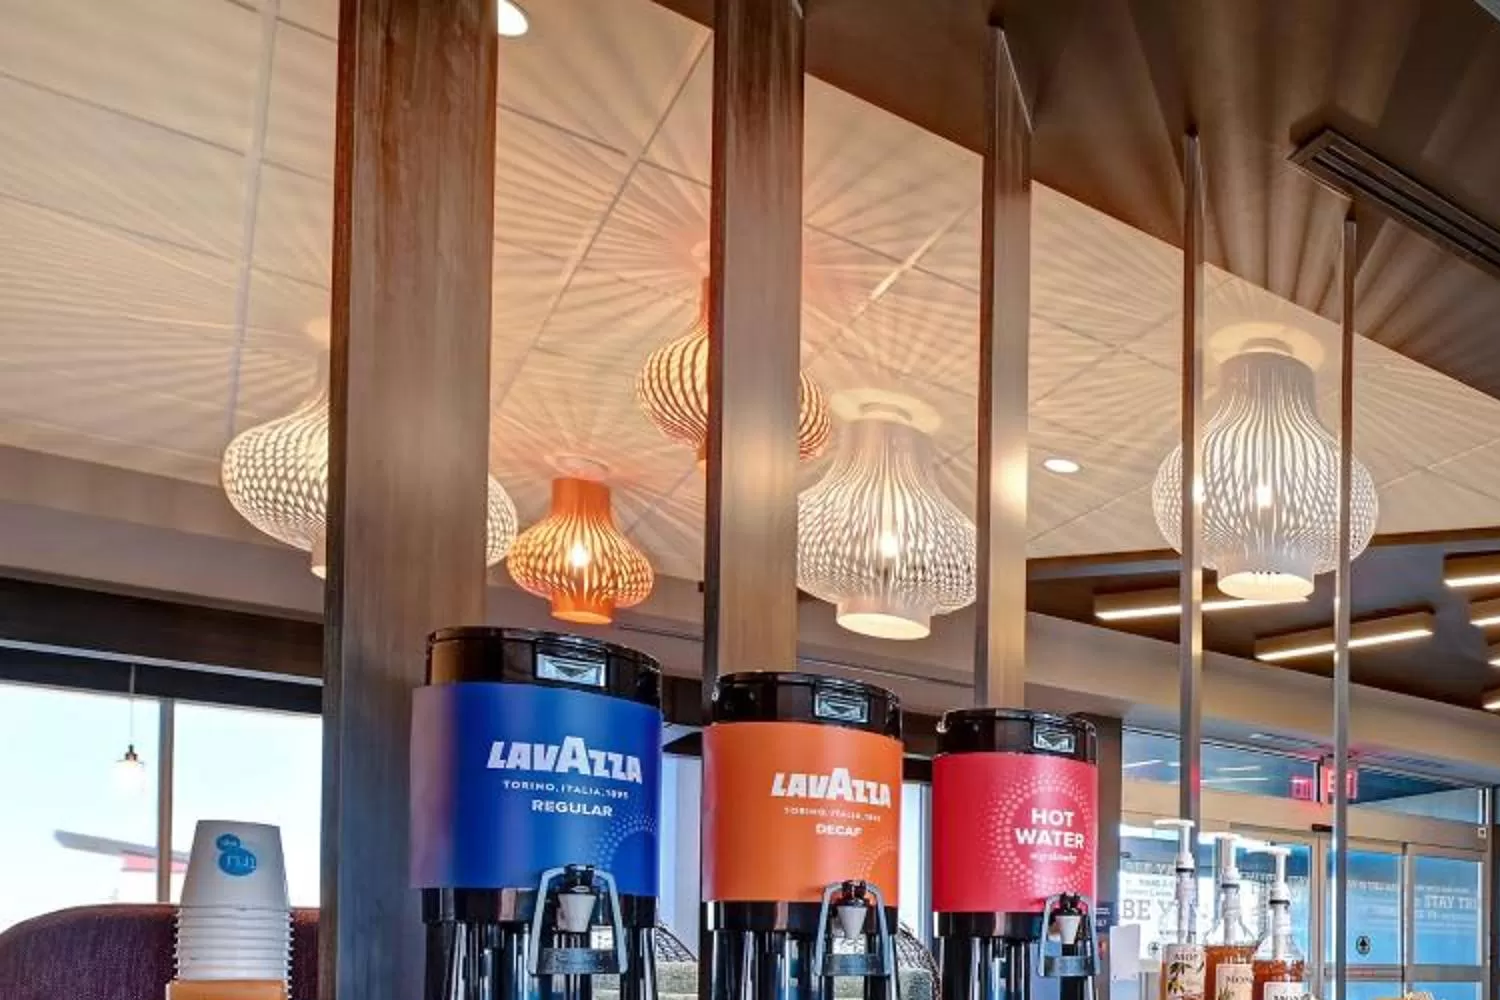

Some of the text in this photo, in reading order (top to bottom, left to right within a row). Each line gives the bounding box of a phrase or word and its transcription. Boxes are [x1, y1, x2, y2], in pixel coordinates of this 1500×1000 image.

[486, 735, 643, 784] LAVAZZA
[771, 767, 891, 809] LAVAZZA
[531, 799, 613, 817] REGULAR
[1031, 807, 1075, 828] HOT
[815, 823, 864, 837] DECAF
[1014, 827, 1084, 849] WATER
